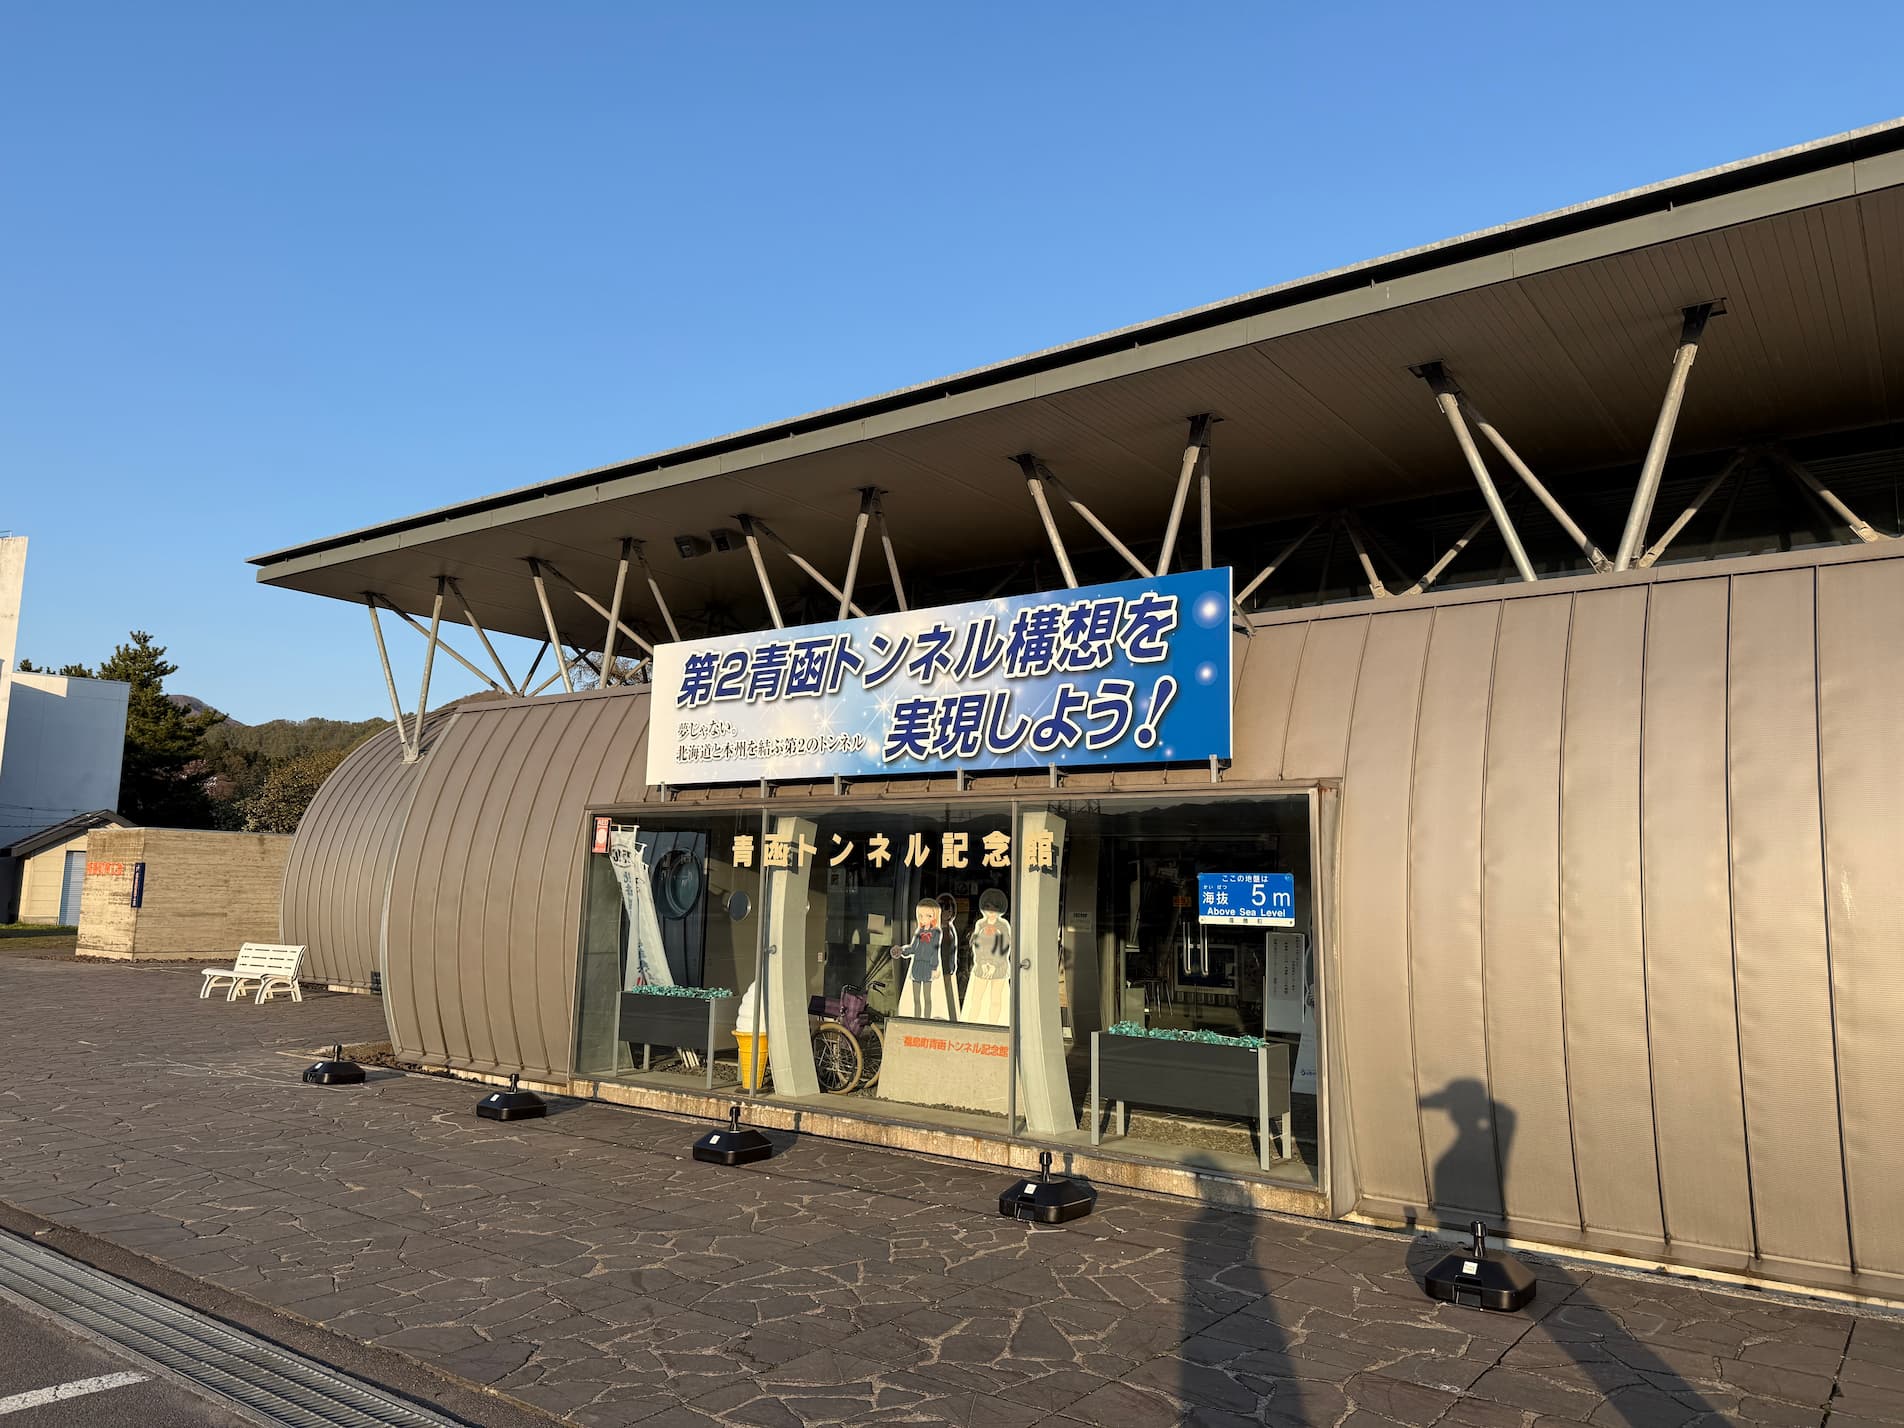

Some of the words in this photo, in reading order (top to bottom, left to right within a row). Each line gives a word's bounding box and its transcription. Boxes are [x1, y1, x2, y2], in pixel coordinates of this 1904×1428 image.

[678, 593, 1178, 707] 第2青函トンネル構想を
[678, 720, 737, 739] 夢じゃない。
[676, 733, 865, 762] 北海道と本州を結ぶ第2のトンネル
[732, 829, 1055, 868] 青函トンネル記念館
[1222, 875, 1269, 883] ここの地盤は
[1202, 891, 1229, 905] 海抜
[1251, 884, 1267, 906] 5
[1273, 892, 1291, 907] m
[1207, 907, 1236, 916] Above
[1239, 908, 1256, 916] Sea
[1260, 909, 1286, 917] Level
